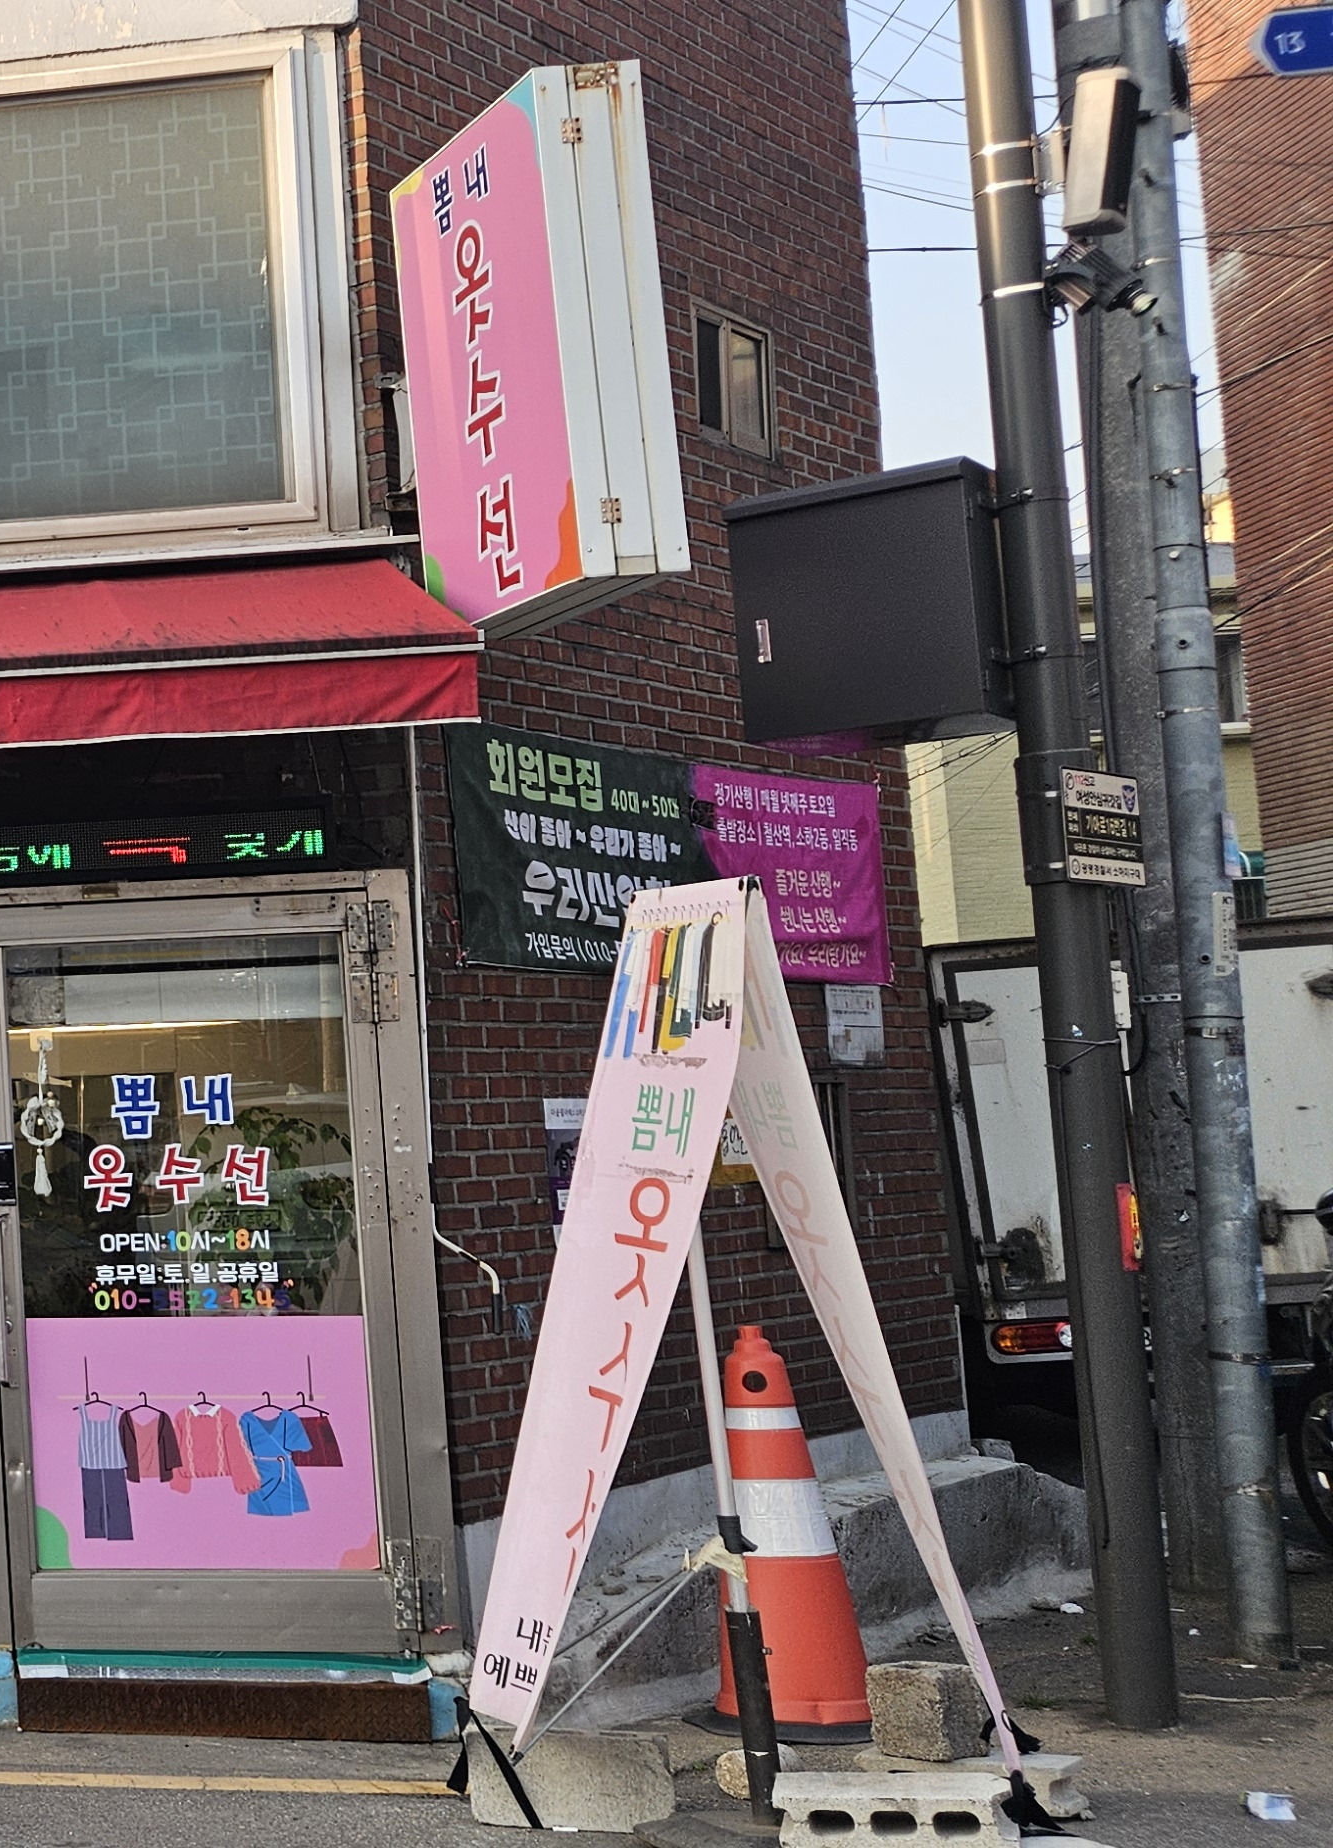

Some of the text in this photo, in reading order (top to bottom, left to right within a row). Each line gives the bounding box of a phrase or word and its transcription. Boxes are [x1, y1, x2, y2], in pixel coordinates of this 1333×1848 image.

[487, 739, 603, 812] 회원모집
[809, 795, 836, 818] 토요일
[504, 809, 667, 862] 산이 좋아 우리가 좋아
[717, 817, 757, 844] 출발장소
[522, 860, 671, 927] 우리산
[525, 932, 579, 961] 가입문의
[111, 1073, 234, 1140] 뽐내
[632, 1084, 695, 1158] 뽐내
[84, 1143, 270, 1212] 옷수선
